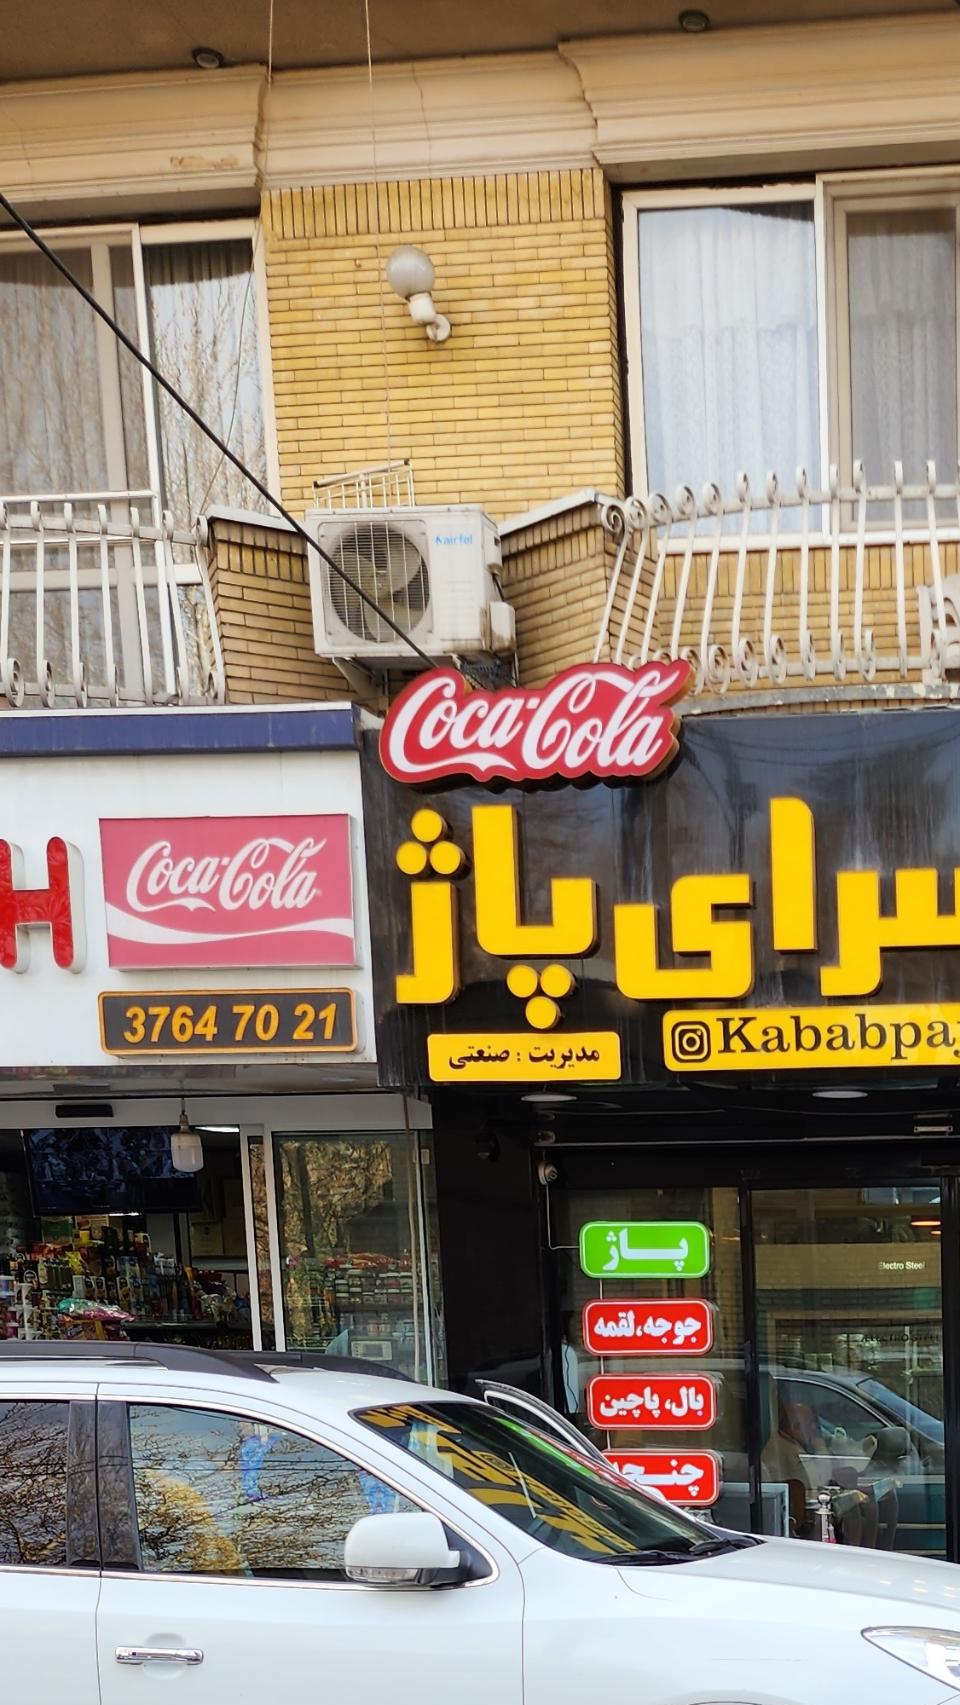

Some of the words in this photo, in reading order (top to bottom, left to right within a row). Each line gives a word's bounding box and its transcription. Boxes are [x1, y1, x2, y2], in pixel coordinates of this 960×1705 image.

[389, 667, 680, 776] Coca-Cola
[126, 836, 327, 913] Coca-Cola
[396, 805, 597, 1030] پاژ
[123, 1004, 218, 1044] 3764
[233, 1003, 280, 1041] 70
[293, 1002, 338, 1040] 21
[449, 1046, 511, 1069] صنعتی
[529, 1046, 600, 1069] مدیریت
[602, 1228, 689, 1271] پاژ
[600, 1386, 660, 1418] پاچین
